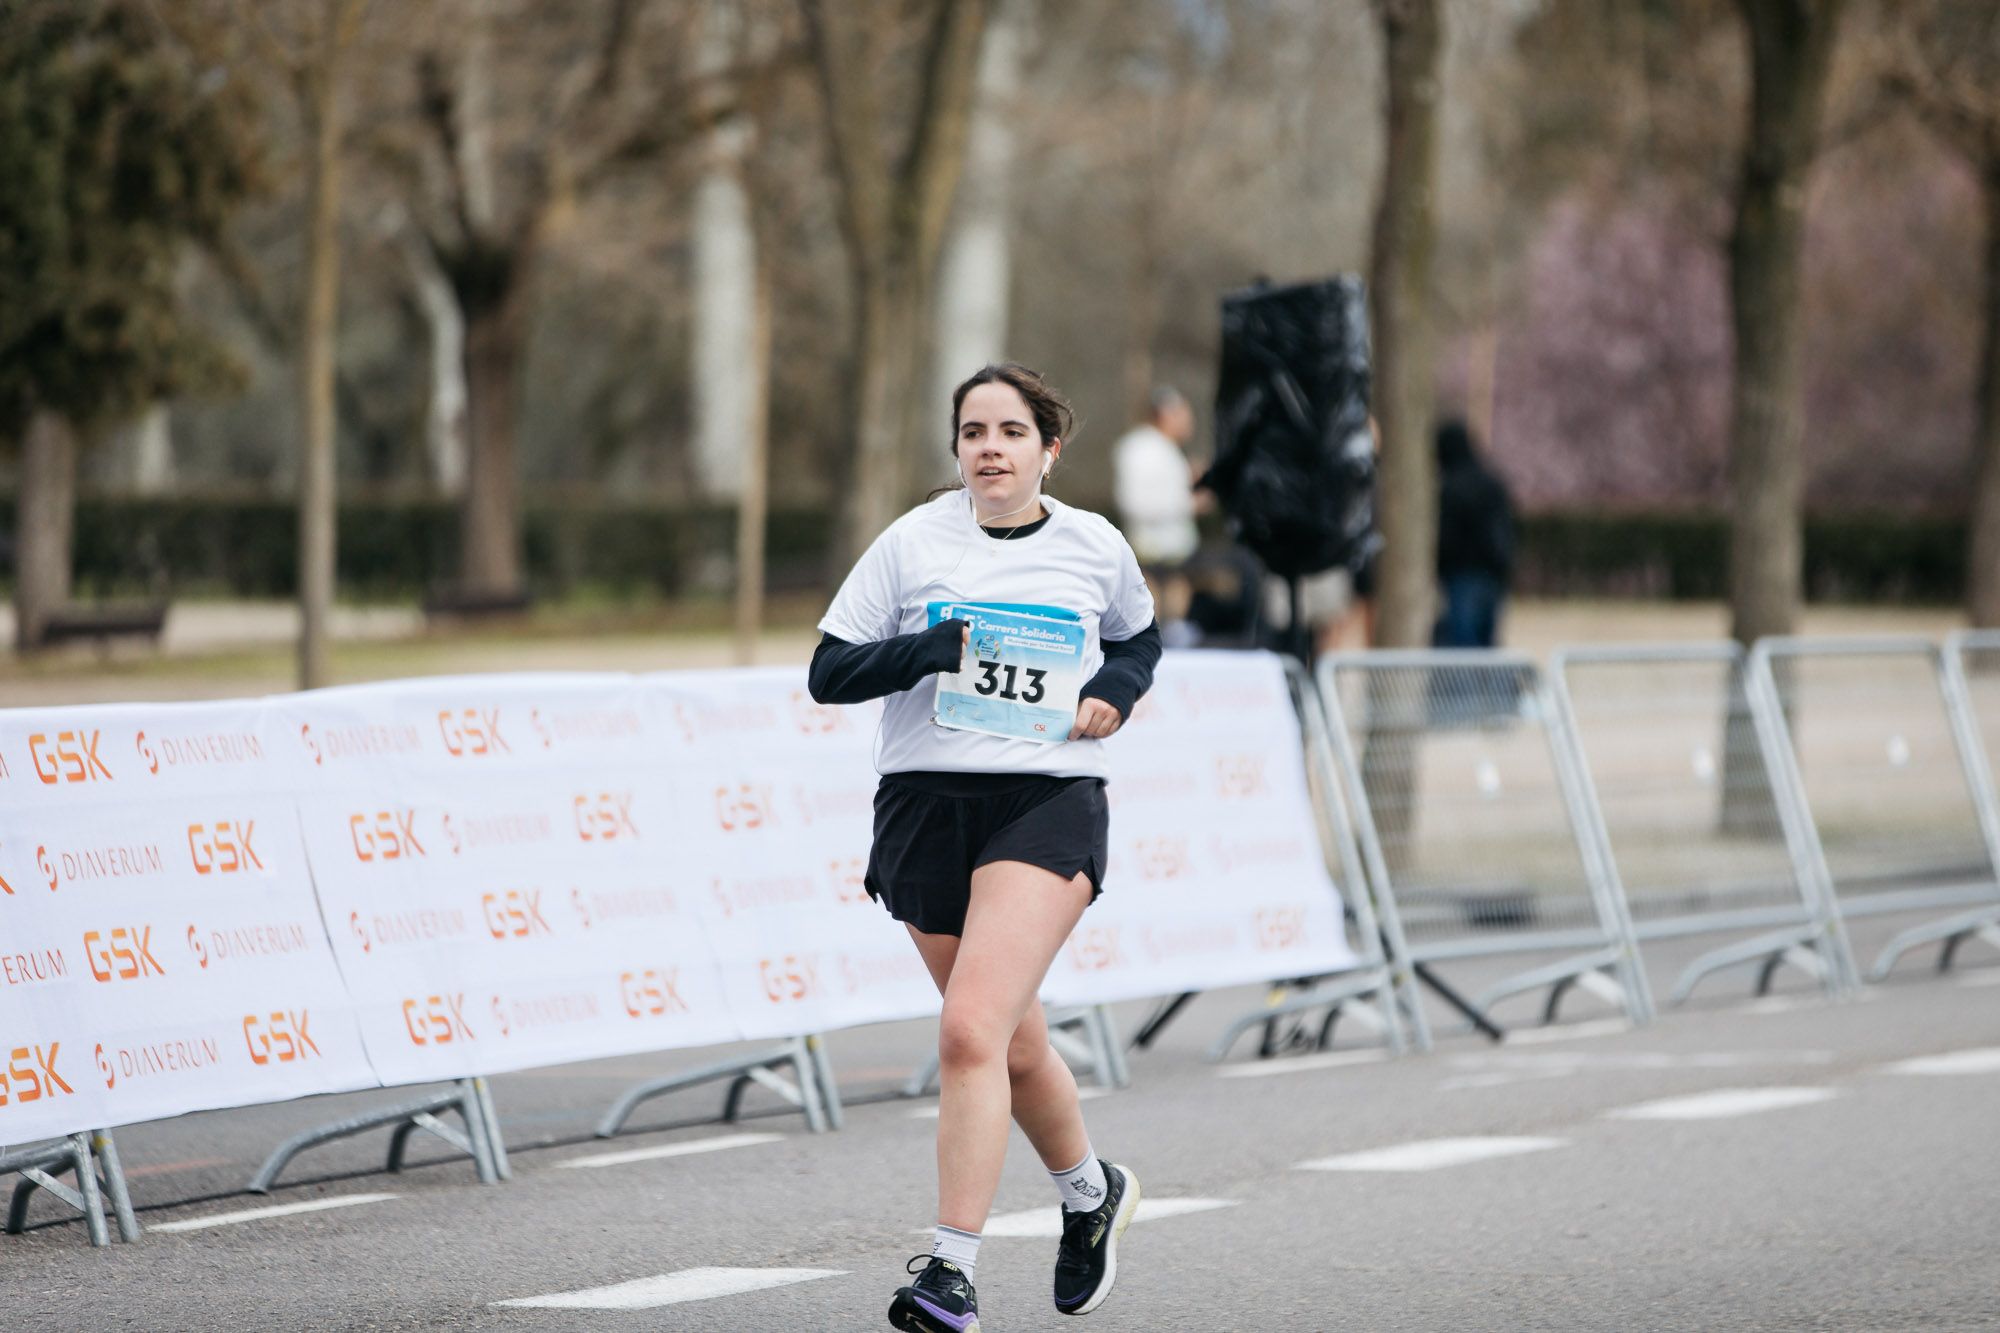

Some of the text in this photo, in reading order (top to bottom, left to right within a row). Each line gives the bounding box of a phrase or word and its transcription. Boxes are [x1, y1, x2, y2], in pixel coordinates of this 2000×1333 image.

[978, 619, 1019, 635] Carrera
[1021, 626, 1066, 642] Solidaria
[975, 660, 1048, 703] 313
[28, 729, 113, 784] GSK
[162, 732, 264, 766] DIAVERUM
[438, 708, 511, 756] GSK
[350, 809, 425, 862] GSK
[573, 792, 639, 841] GSK
[62, 844, 164, 882] DIAVERUM
[187, 820, 264, 874] GSK
[482, 888, 553, 939] GSK
[83, 925, 165, 982] GSK
[211, 924, 309, 960] DIAVERUM
[619, 966, 688, 1018] GSK
[243, 1008, 321, 1065] GSK
[402, 993, 475, 1045] GSK
[119, 1036, 222, 1078] DIAVERUM
